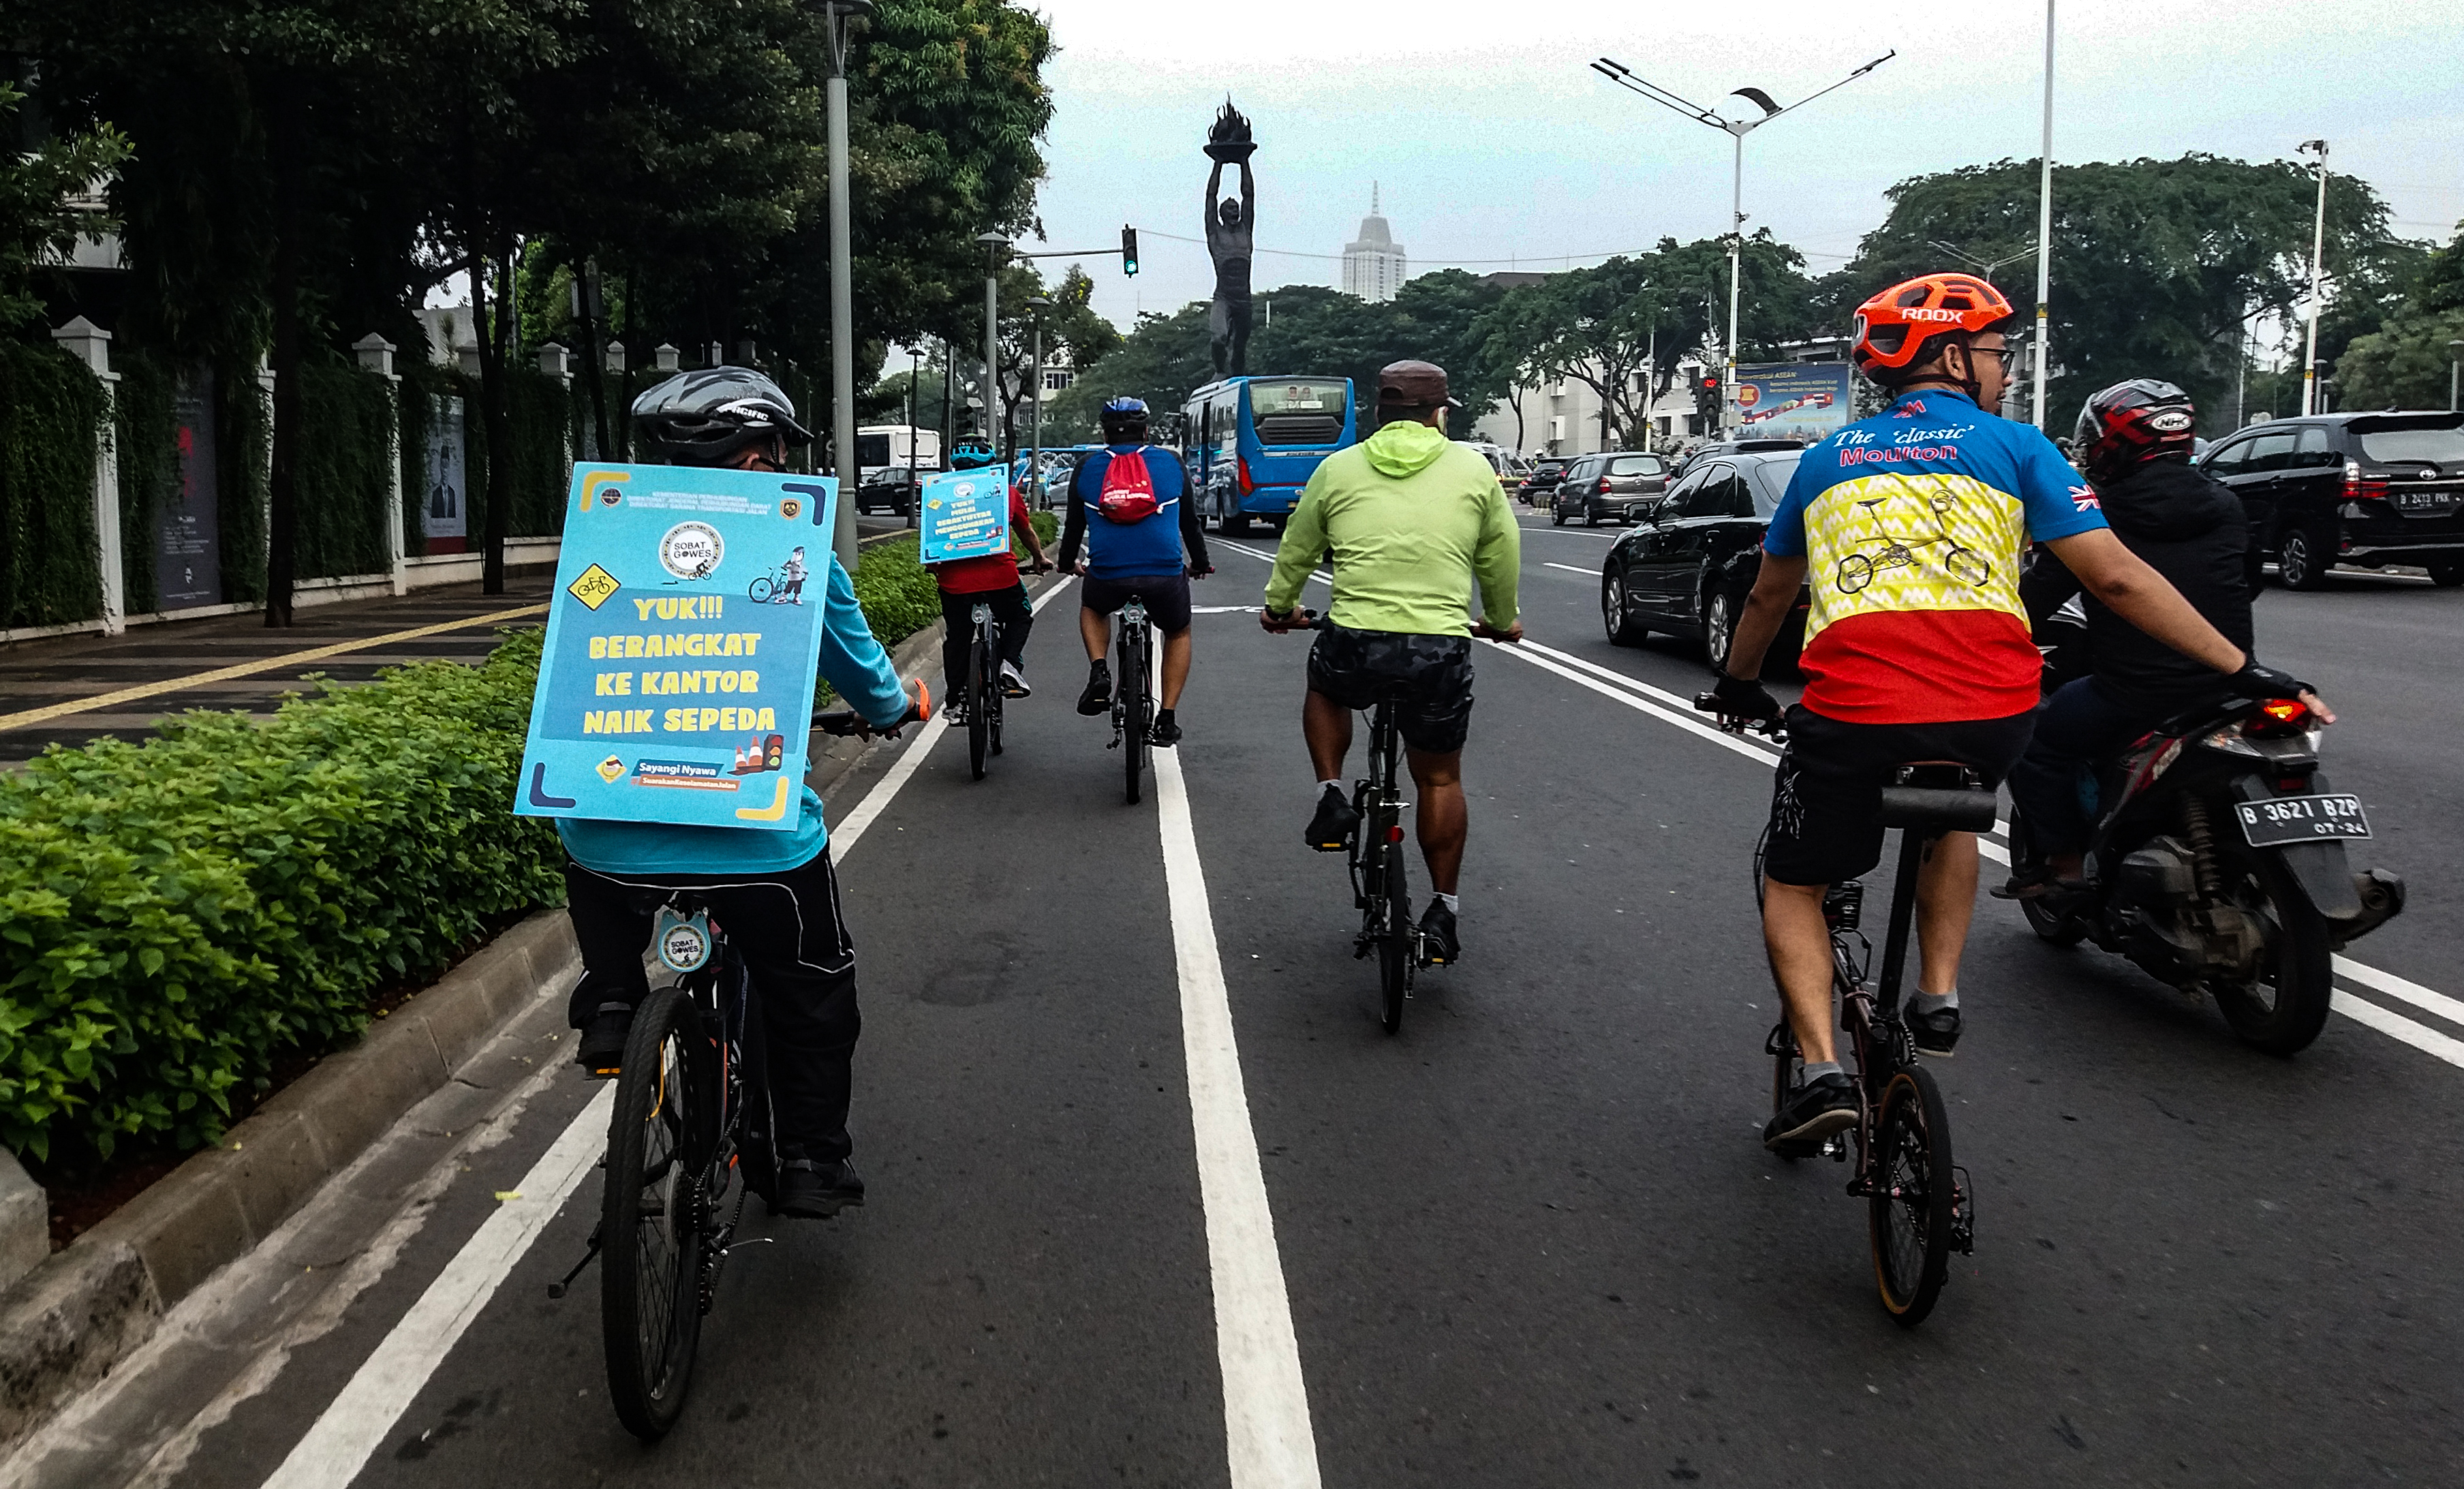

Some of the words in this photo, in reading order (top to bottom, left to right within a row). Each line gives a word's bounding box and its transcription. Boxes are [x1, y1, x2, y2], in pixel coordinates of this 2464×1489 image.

[2159, 416, 2188, 427] NHK
[1833, 429, 1876, 447] The
[1840, 445, 1958, 467] Moulton
[674, 542, 706, 551] SOBAT
[674, 549, 711, 558] GOWES
[634, 596, 723, 621] YUK!!!
[589, 633, 761, 659] BERANGKAT
[596, 672, 632, 696] KE
[641, 671, 759, 695] KANTOR
[583, 709, 653, 734] NAIK
[663, 707, 775, 733] SEPEDA
[639, 763, 680, 776] Sayangi
[681, 765, 716, 776] Nyawa
[2242, 806, 2258, 825] B
[2264, 800, 2315, 821] 3621
[2321, 799, 2358, 817] BZP
[671, 939, 694, 948] SOBAT
[672, 945, 698, 955] GOWES
